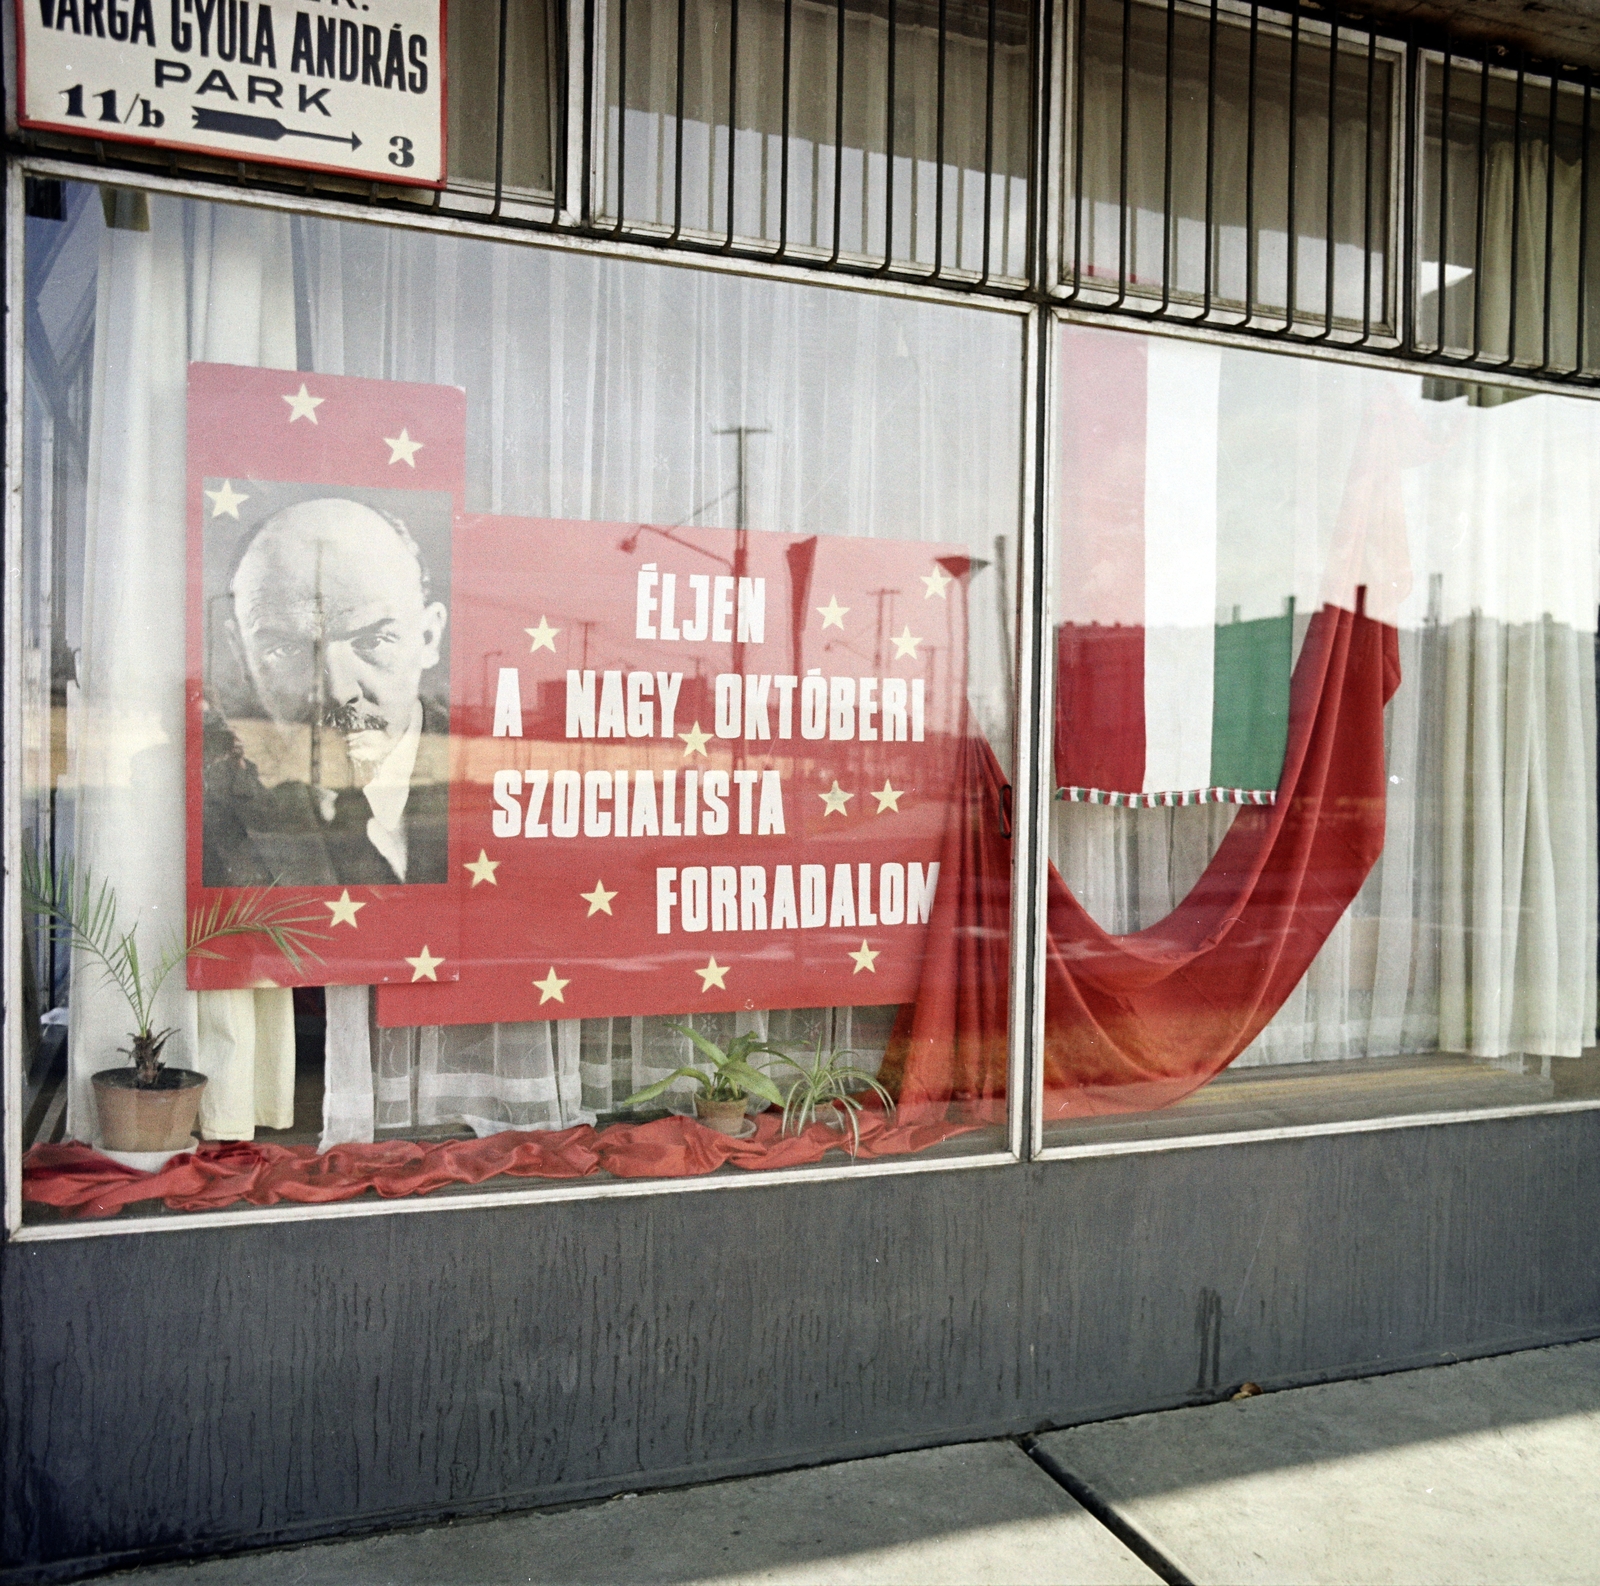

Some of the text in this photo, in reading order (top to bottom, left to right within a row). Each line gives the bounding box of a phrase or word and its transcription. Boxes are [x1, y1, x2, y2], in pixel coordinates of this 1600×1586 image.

[170, 0, 277, 69] GYULA
[290, 12, 428, 94] ANDRÁS
[58, 83, 165, 128] 11/b
[154, 58, 333, 117] PARK
[387, 136, 415, 168] 3
[635, 562, 766, 643] ÉLJEN
[492, 667, 925, 742] A NAGY OKTÓBERI
[492, 769, 786, 838] SZOCIALISTA
